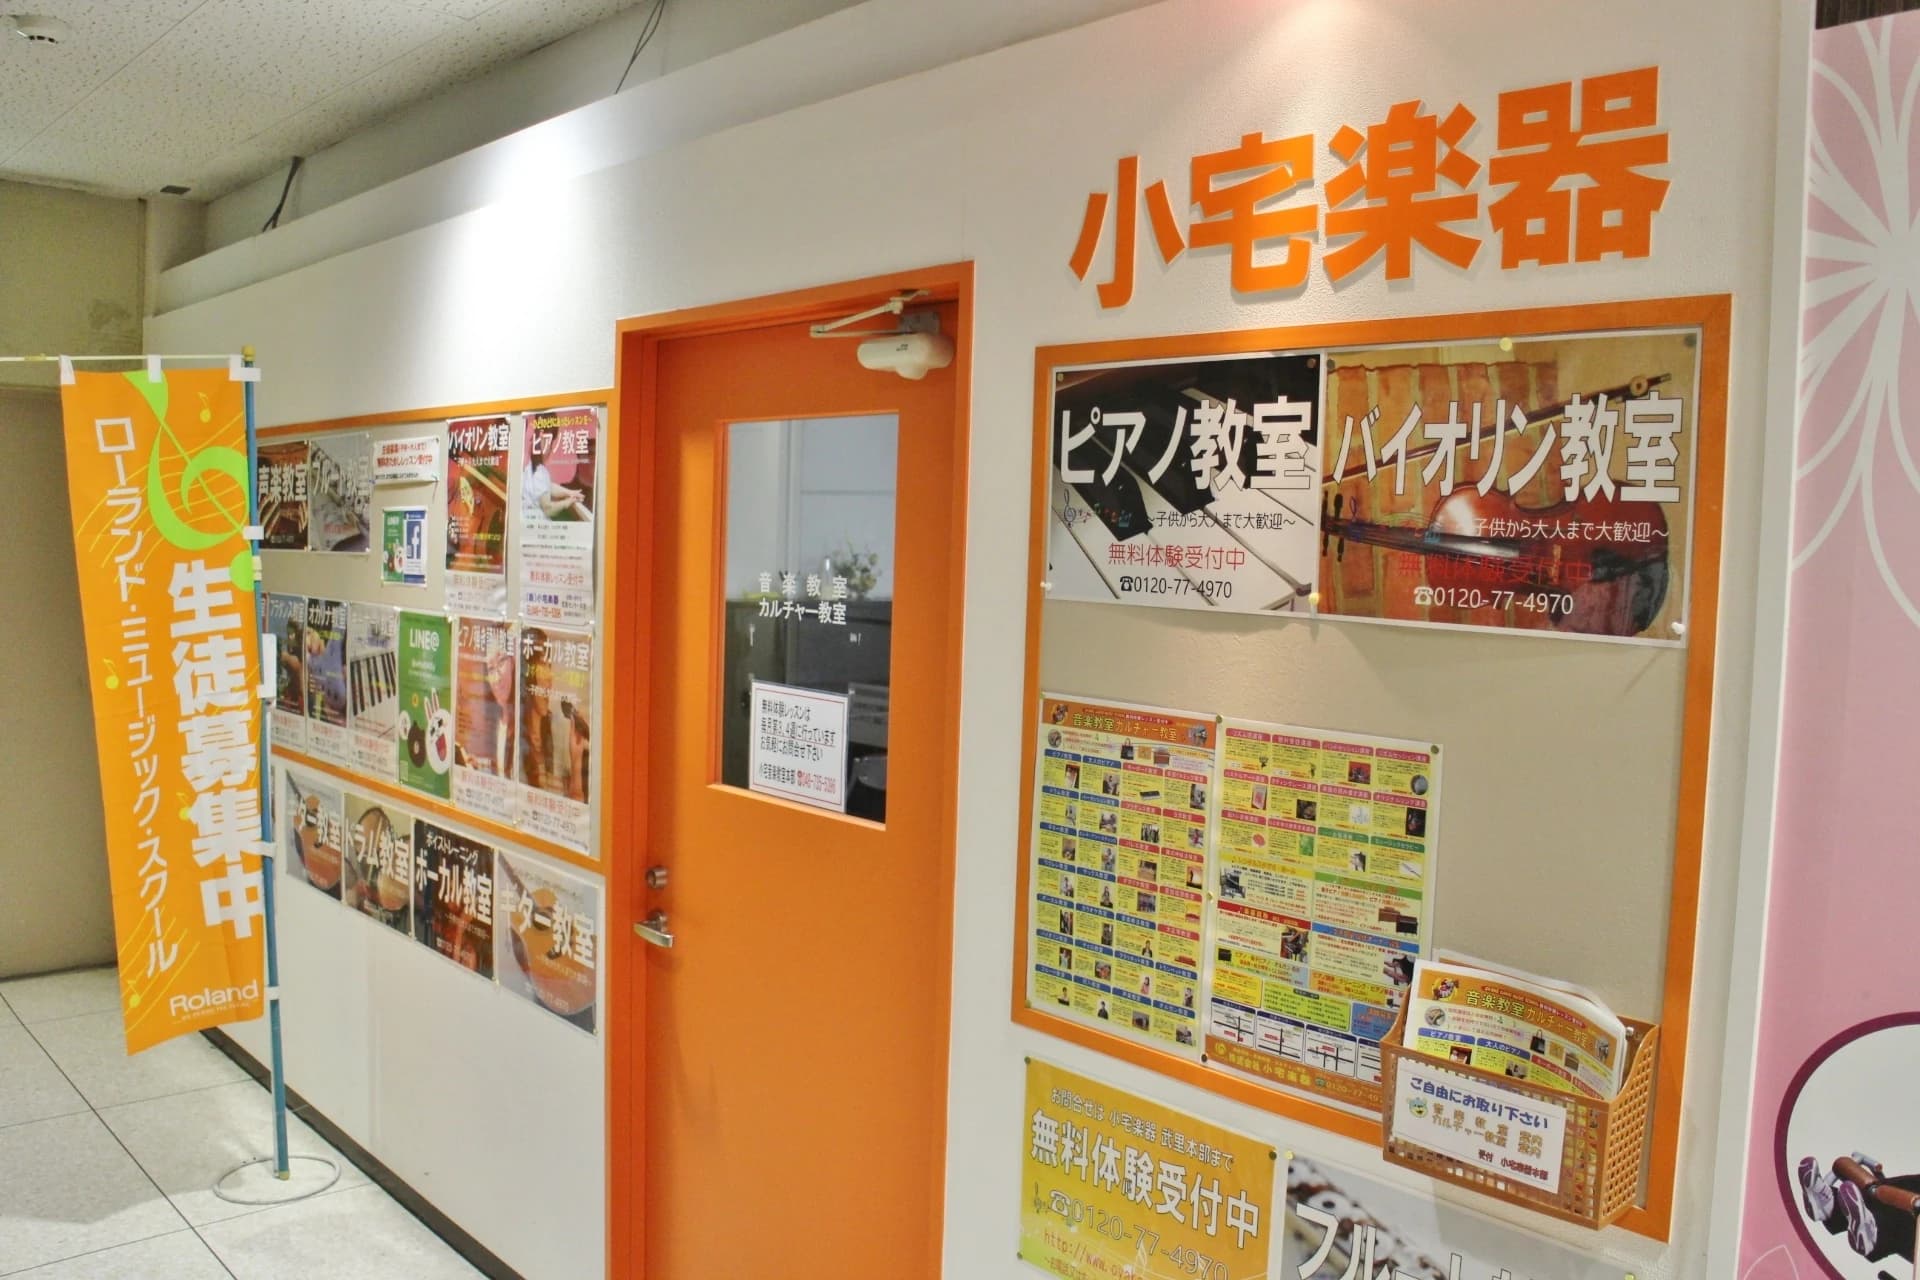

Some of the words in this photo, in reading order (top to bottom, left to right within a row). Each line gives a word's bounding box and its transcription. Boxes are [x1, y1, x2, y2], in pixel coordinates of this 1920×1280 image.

[1068, 66, 1670, 308] 小宅楽器
[448, 423, 509, 451] バイオリン教室
[532, 429, 589, 455] ピアノ教室
[1061, 396, 1311, 491] ピアノ教室
[1333, 390, 1683, 503] バイオリン教室
[258, 462, 307, 502] 声楽教室
[1108, 543, 1245, 571] 無料体験受付中
[1399, 552, 1593, 582] 無料体験受付中
[1133, 576, 1232, 598] 0120-77-4970
[1433, 587, 1574, 615] 0120-77-4970
[758, 598, 847, 625] カルチャー教室
[409, 628, 440, 651] LINE@
[522, 634, 589, 672] ボーカル教室
[95, 416, 179, 978] ローランド・ミュージック・スクール
[1072, 712, 1115, 732] 音楽教室
[1116, 719, 1177, 741] カルチャー教室
[168, 560, 265, 939] 生徒募集中
[345, 815, 409, 886] ドラム教室
[426, 831, 480, 866] ボイストレーニング
[416, 847, 493, 925] ボーカル教室
[500, 883, 595, 969] ギター教室
[169, 979, 259, 1016] Roland
[1430, 1030, 1462, 1042] ピアノ教室
[1466, 989, 1525, 1018] 音楽教室
[1526, 1007, 1588, 1048] カルチャー教室
[1486, 1040, 1521, 1055] 大人のピアノ
[1410, 1076, 1549, 1129] ご自由にお取り下さい
[1051, 1087, 1105, 1121] お問合せは
[1110, 1111, 1157, 1142] 小宅楽器
[1161, 1127, 1235, 1172] 武里本部まで
[1431, 1114, 1507, 1148] カルチャー教室
[1478, 1148, 1494, 1163] 受付
[1031, 1108, 1259, 1249] 無料体験受付中
[1071, 1199, 1229, 1280] 0120-77-4970
